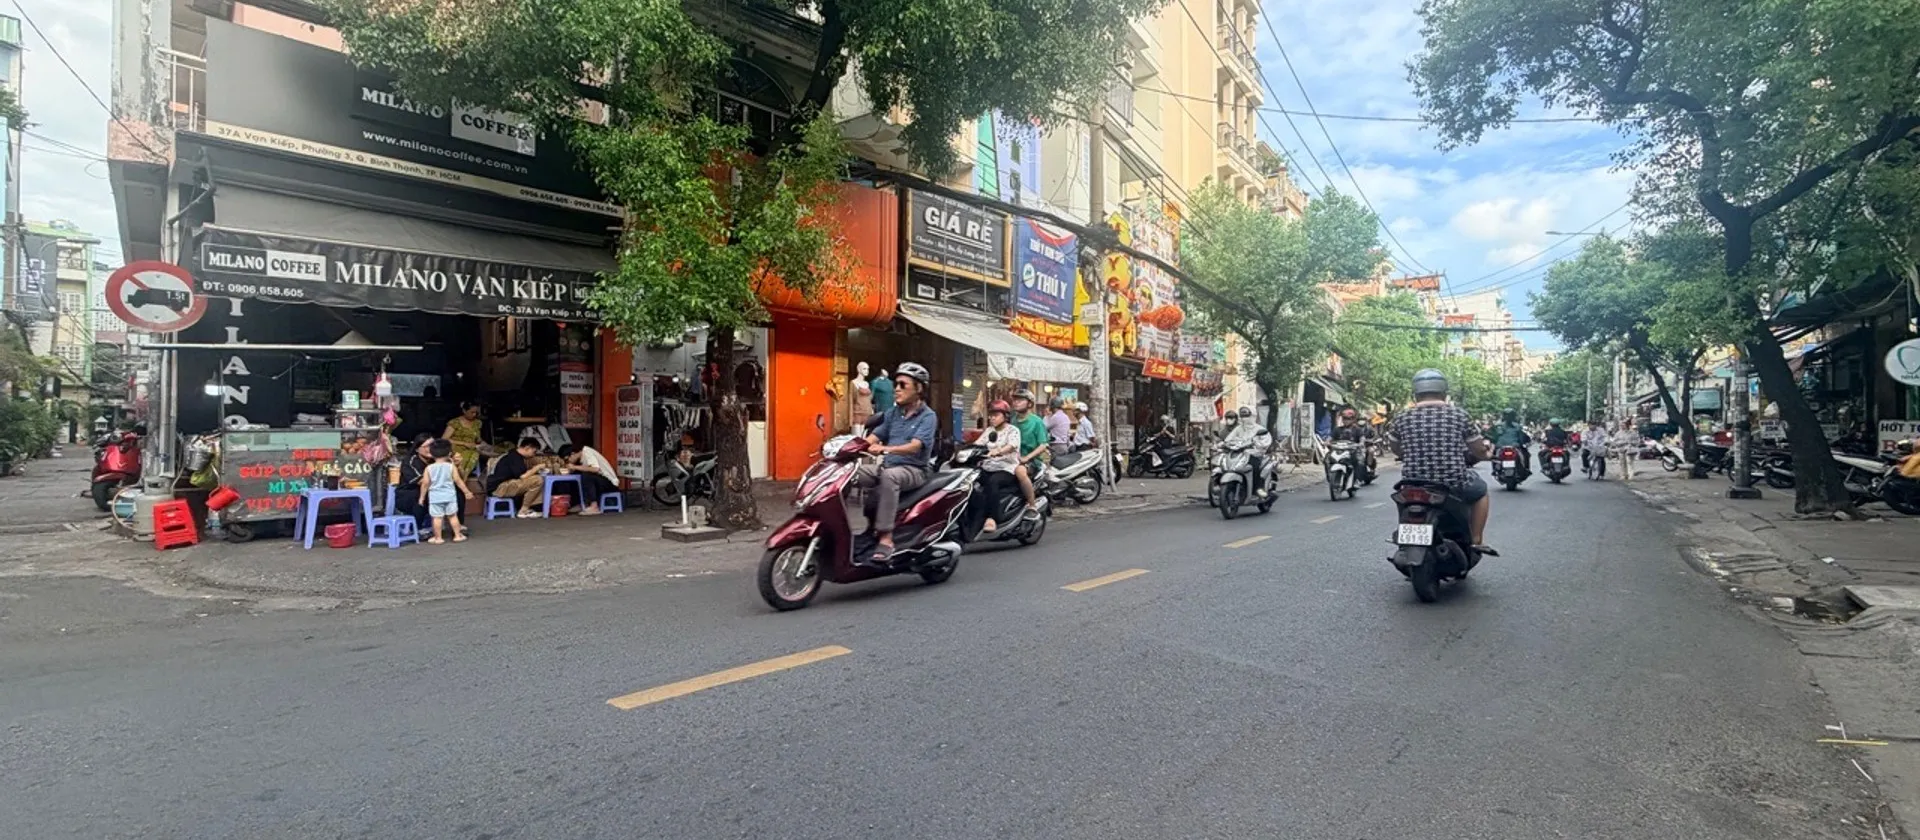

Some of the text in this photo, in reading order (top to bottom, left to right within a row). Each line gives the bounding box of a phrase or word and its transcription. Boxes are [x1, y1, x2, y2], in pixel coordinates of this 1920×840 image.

[461, 114, 529, 141] COFFEE
[217, 126, 241, 139] 37A
[244, 131, 267, 144] Vạn
[270, 137, 299, 151] Kiếp,
[301, 143, 342, 160] Phường
[362, 130, 528, 174] www.milanocoffee.com.vn
[925, 206, 960, 234] GIÁ
[966, 219, 993, 244] RẺ
[208, 251, 321, 275] MILANO COFFEE
[203, 282, 304, 298] ĐT: 0906.658.605
[335, 260, 447, 293] MILANO
[454, 272, 506, 300] VẠN
[512, 273, 567, 301] KIẾP
[1037, 272, 1058, 297] THÚ
[1061, 281, 1067, 300] Y
[498, 304, 514, 314] ĐC:
[516, 305, 532, 315] 37A
[534, 307, 550, 316] Vạn
[552, 308, 570, 319] Kiếp
[239, 463, 275, 479] SÚP
[344, 459, 372, 474] CẢO
[268, 478, 310, 493] MÌ XÀ
